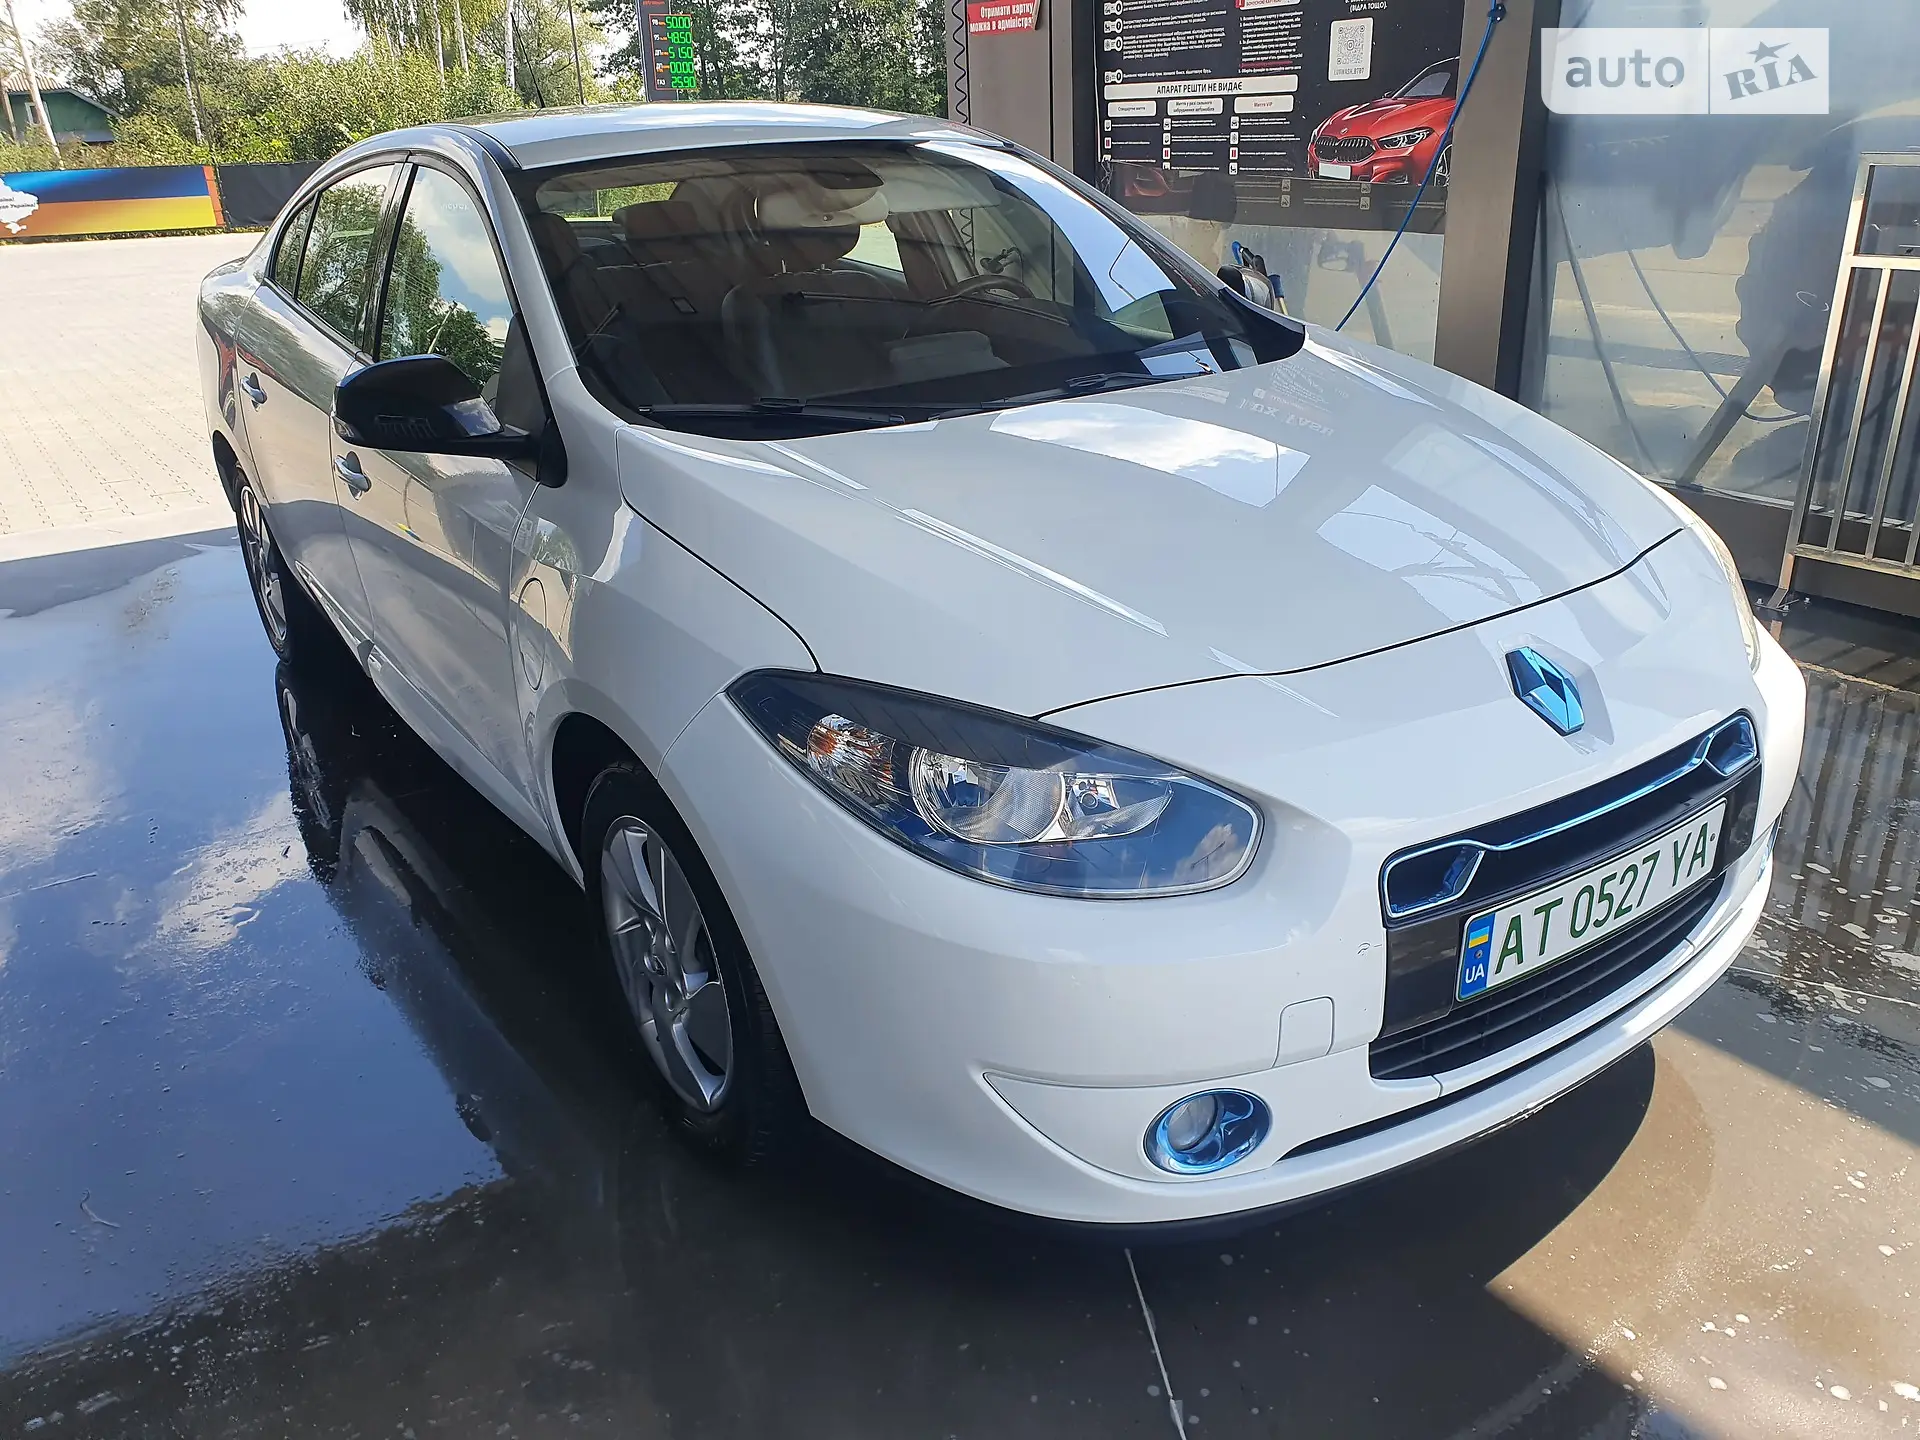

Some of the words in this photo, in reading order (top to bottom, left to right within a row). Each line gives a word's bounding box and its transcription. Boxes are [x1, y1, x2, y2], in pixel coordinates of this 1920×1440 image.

[980, 5, 1011, 19] Отримати
[1012, 2, 1034, 15] картку
[665, 16, 691, 28] 50.00
[969, 21, 991, 33] можна
[992, 20, 997, 30] в
[667, 31, 692, 43] 48.50
[670, 61, 695, 74] 00.00
[672, 76, 697, 88] 25.90
[1156, 84, 1182, 94] АПАРАТ
[1183, 83, 1207, 93] РЕШТИ
[1208, 82, 1217, 92] НЕ
[1218, 81, 1243, 92] ВИДАЄ
[1495, 899, 1563, 975] AT
[1570, 850, 1661, 939] 0527
[1671, 822, 1709, 888] YA
[1465, 967, 1485, 984] UA
